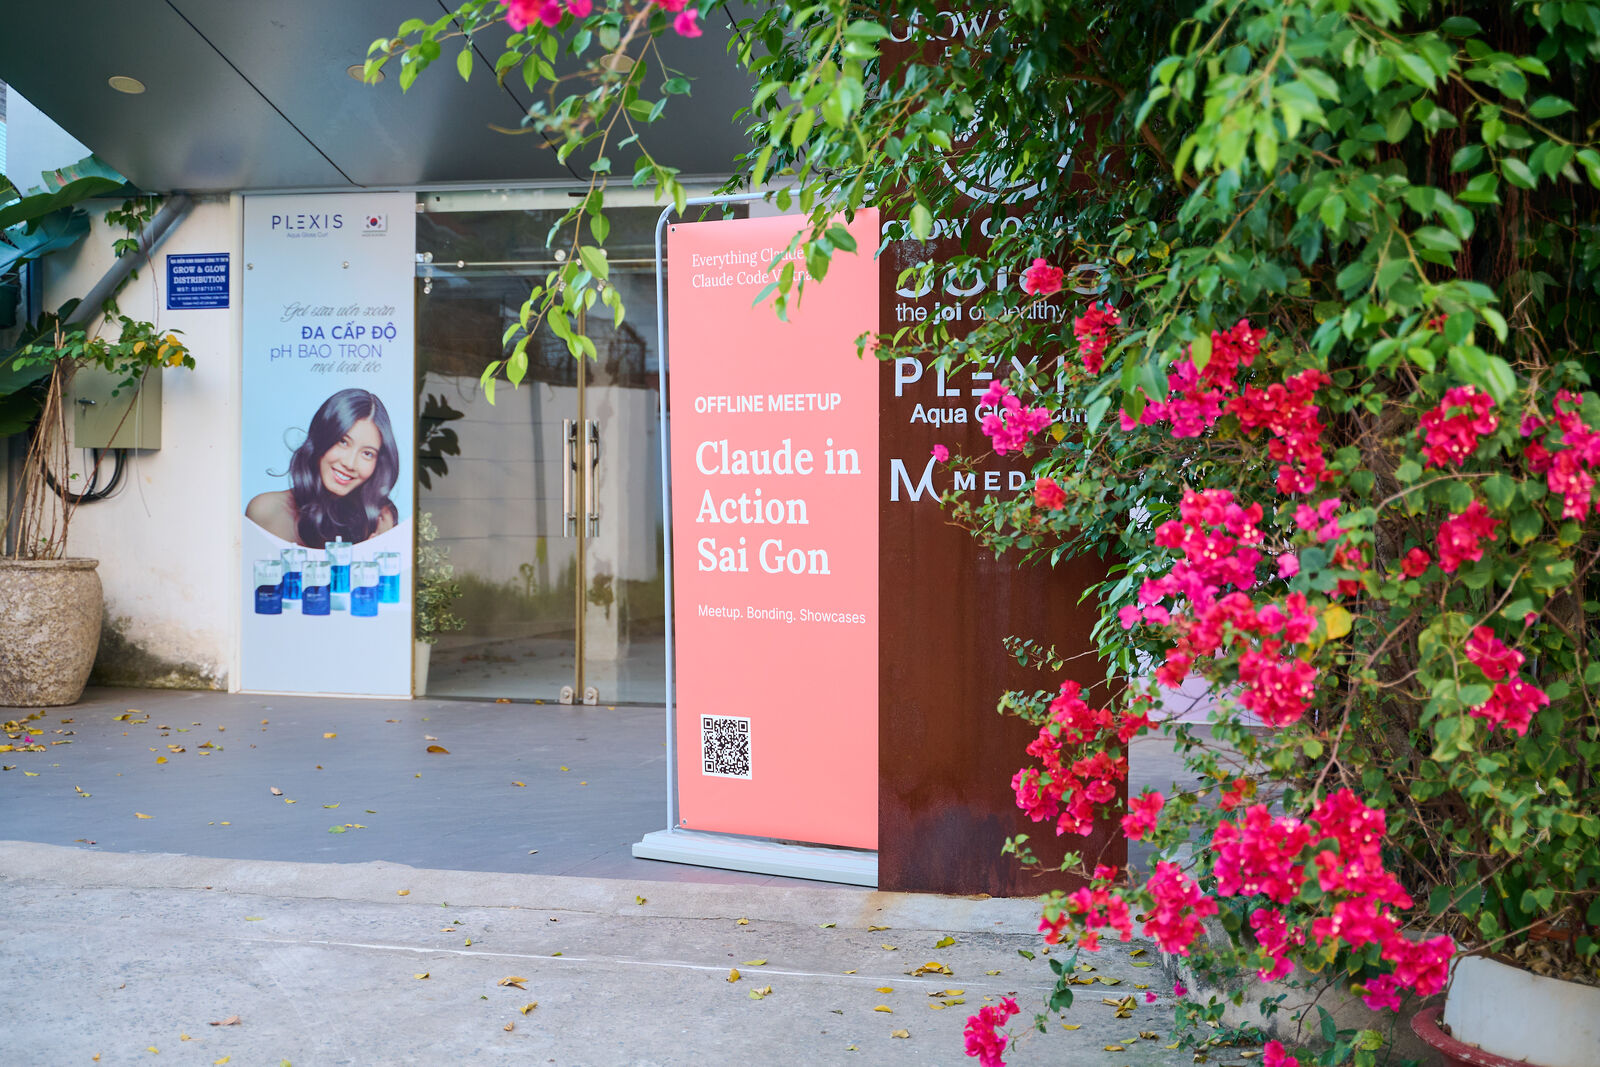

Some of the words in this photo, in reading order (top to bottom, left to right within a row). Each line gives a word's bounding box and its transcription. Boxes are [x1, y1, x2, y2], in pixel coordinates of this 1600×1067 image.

[271, 214, 343, 230] PLEXIS
[173, 265, 195, 274] GROW
[204, 264, 226, 273] GLOW
[692, 250, 758, 270] Everything
[173, 275, 226, 284] DISTRIBUTION
[692, 272, 734, 288] Claude
[736, 270, 769, 285] Code
[896, 303, 927, 321] the
[301, 326, 325, 340] ĐA
[331, 321, 366, 340] CẤP
[371, 322, 397, 343] ĐỘ
[270, 344, 292, 361] pH
[298, 344, 332, 358] BAO
[694, 395, 764, 413] OFFLINE
[768, 393, 842, 412] MEETUP
[910, 403, 967, 428] Aqua
[696, 438, 814, 475] Claude
[824, 438, 861, 475] in
[695, 488, 809, 524] Action
[697, 537, 749, 572] Sai
[759, 539, 831, 575] Gon
[698, 604, 743, 620] Meetup.
[747, 606, 796, 623] Bonding.
[800, 609, 866, 624] Showcases
